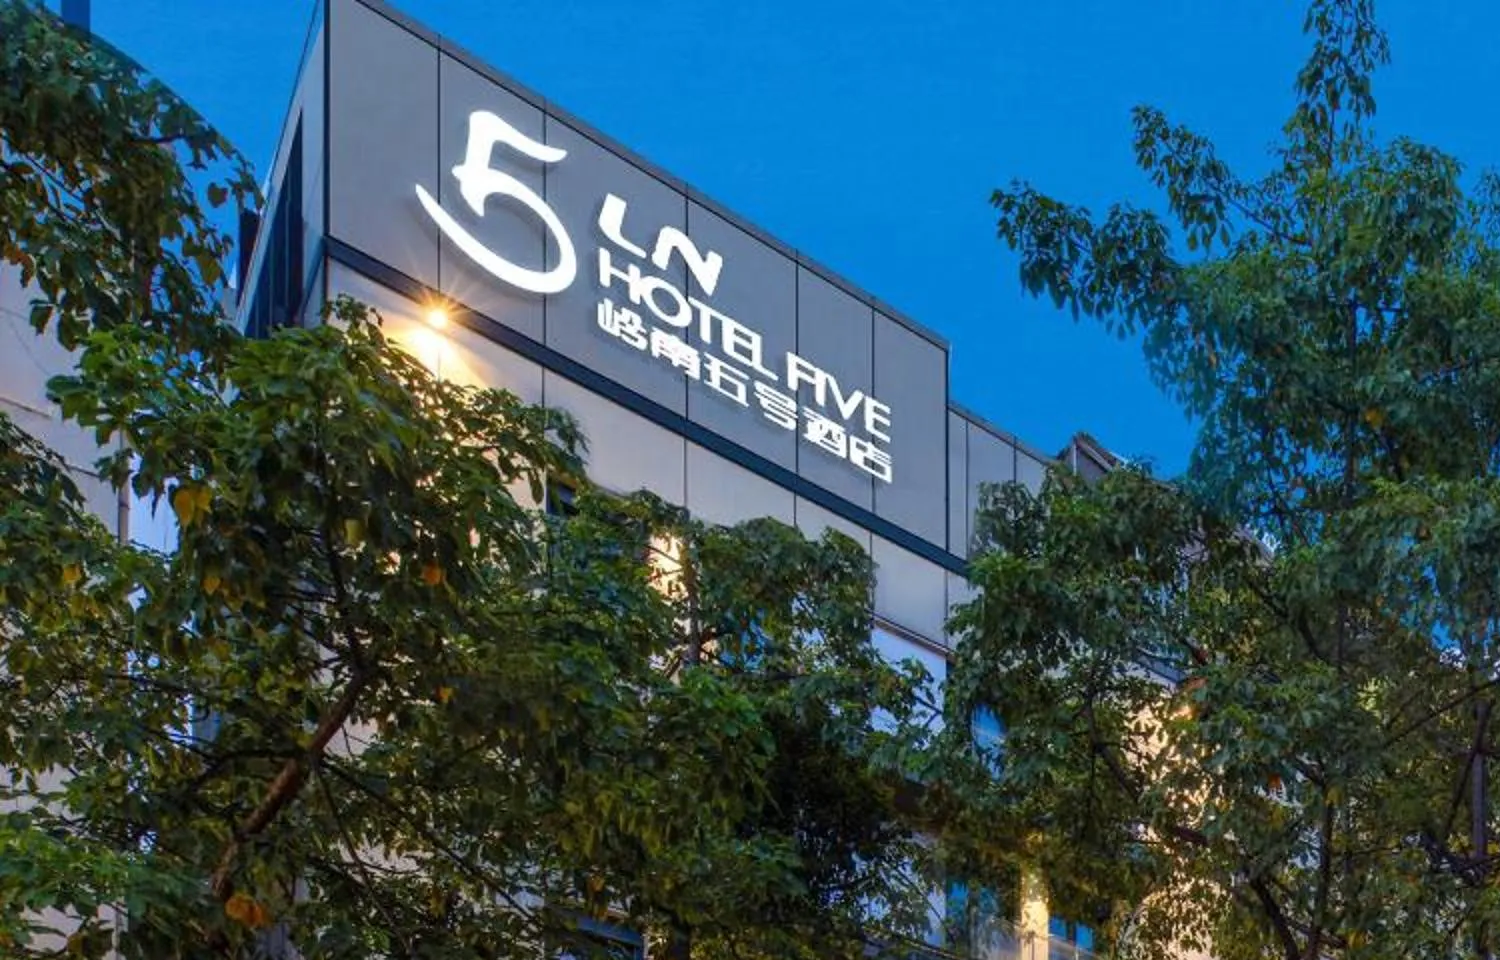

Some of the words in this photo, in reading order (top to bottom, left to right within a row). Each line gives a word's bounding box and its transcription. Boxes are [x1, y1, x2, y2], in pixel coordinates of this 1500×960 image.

[415, 110, 577, 294] 5
[598, 193, 723, 296] LN
[599, 247, 778, 381] HOTEL
[786, 351, 891, 443] FIVE
